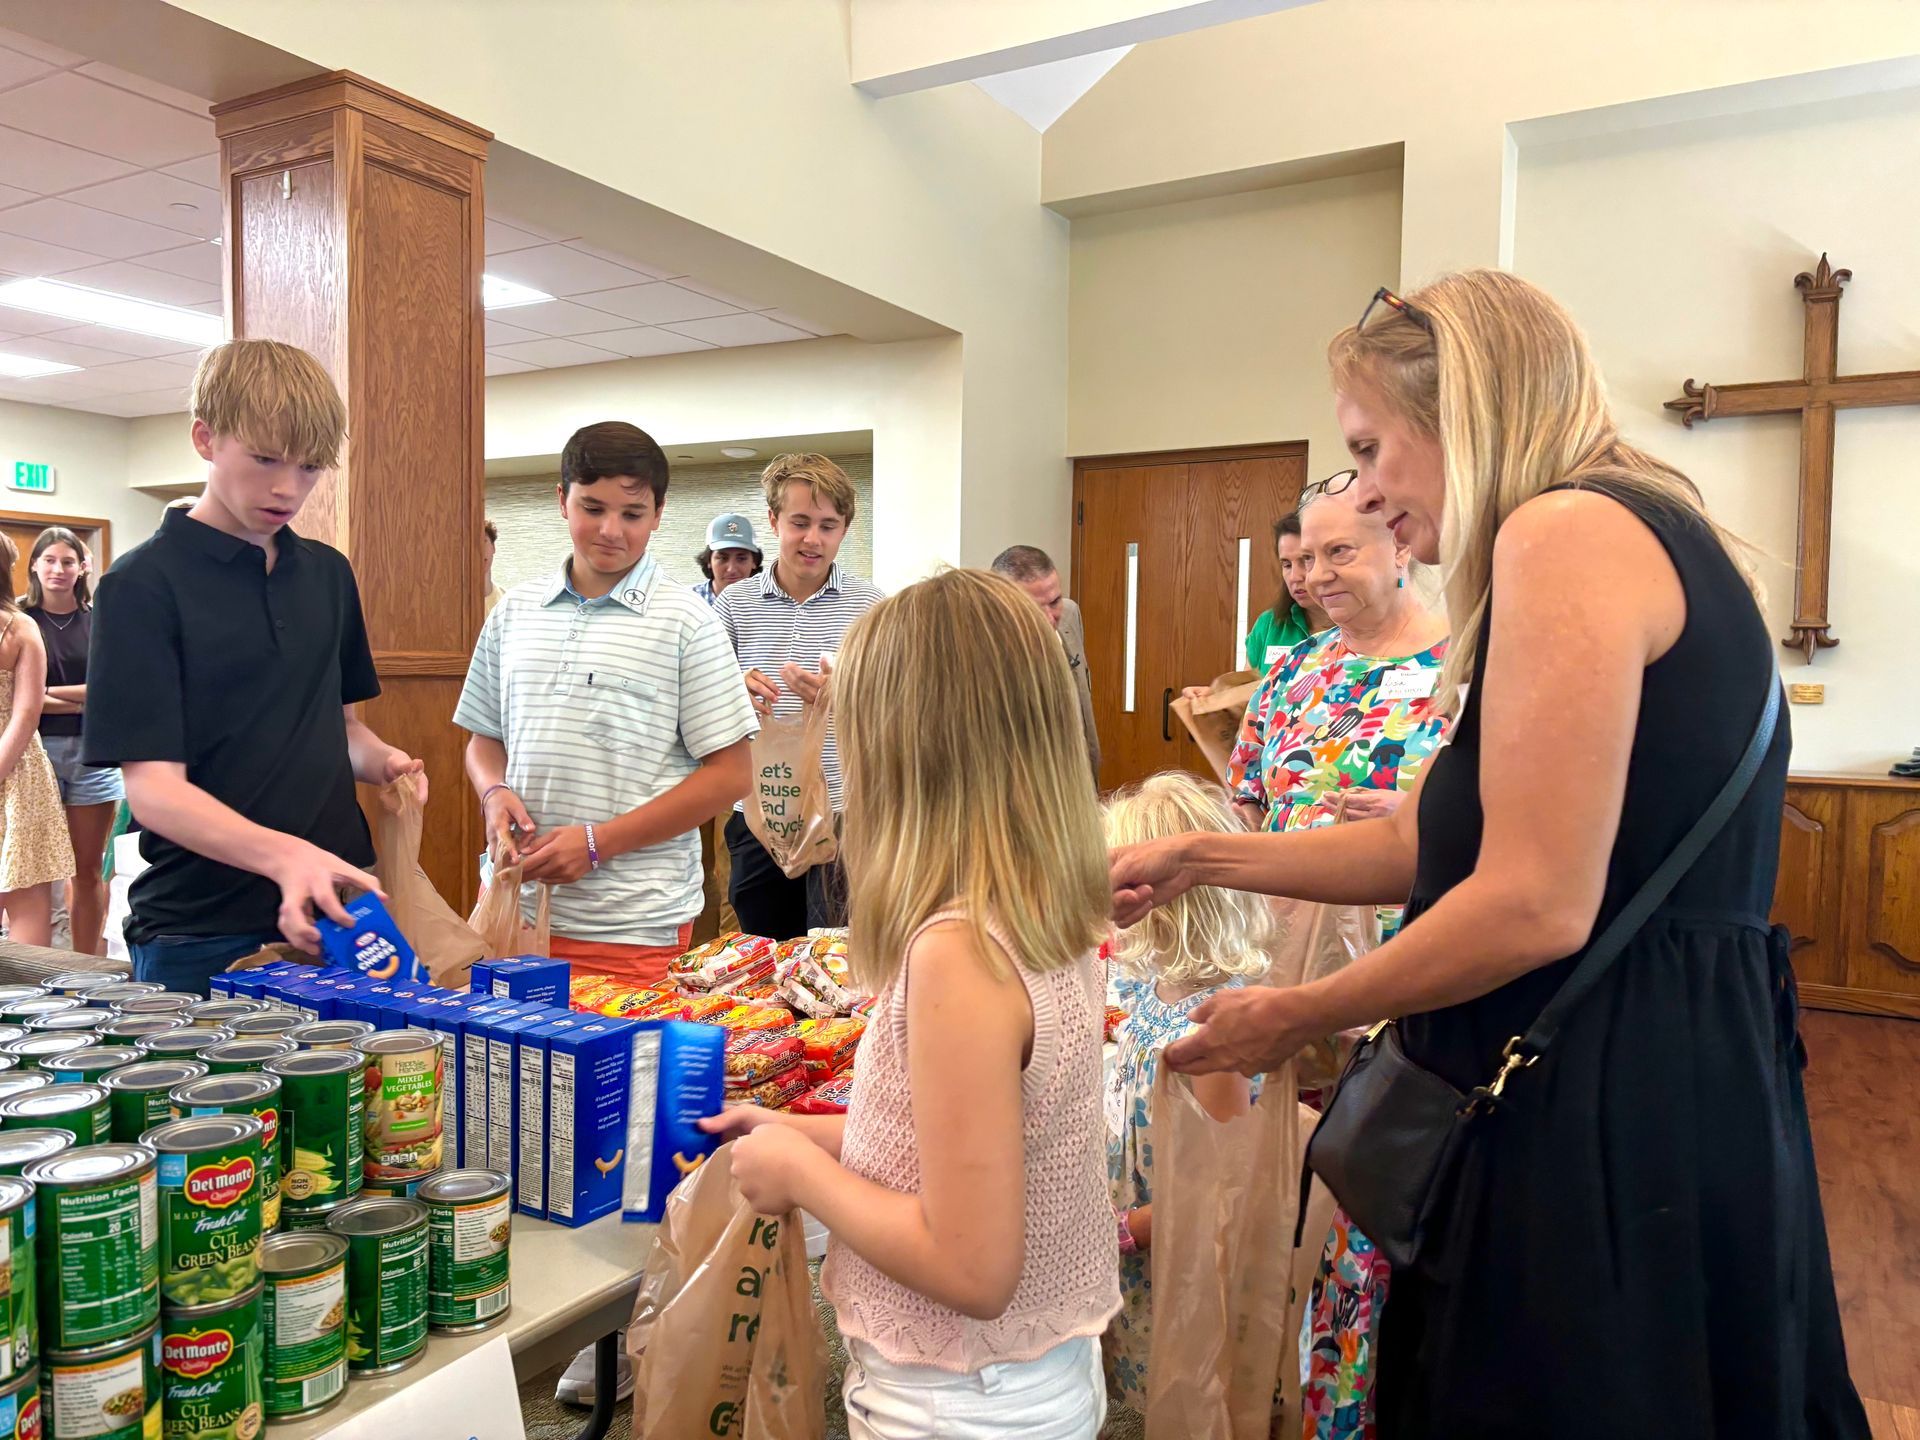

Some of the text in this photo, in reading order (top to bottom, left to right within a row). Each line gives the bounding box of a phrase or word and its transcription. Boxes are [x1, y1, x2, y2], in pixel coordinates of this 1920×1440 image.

[15, 461, 49, 489] EXIT
[760, 762, 792, 779] et's
[386, 1080, 433, 1092] VEGETABLES
[397, 1074, 424, 1084] MIXED
[191, 1168, 252, 1193] Del Monte
[60, 1184, 139, 1206] Nutrition Facts
[194, 1208, 250, 1234] Fresh Cut
[432, 1208, 453, 1216] Facts
[108, 1221, 122, 1234] 20
[209, 1231, 239, 1250] CUT
[382, 1234, 416, 1249] Nutrition
[178, 1234, 260, 1269] GREEN BEANS
[165, 1340, 229, 1359] Del Monte
[181, 1403, 211, 1419] CUT
[199, 1408, 241, 1431] BEANS
